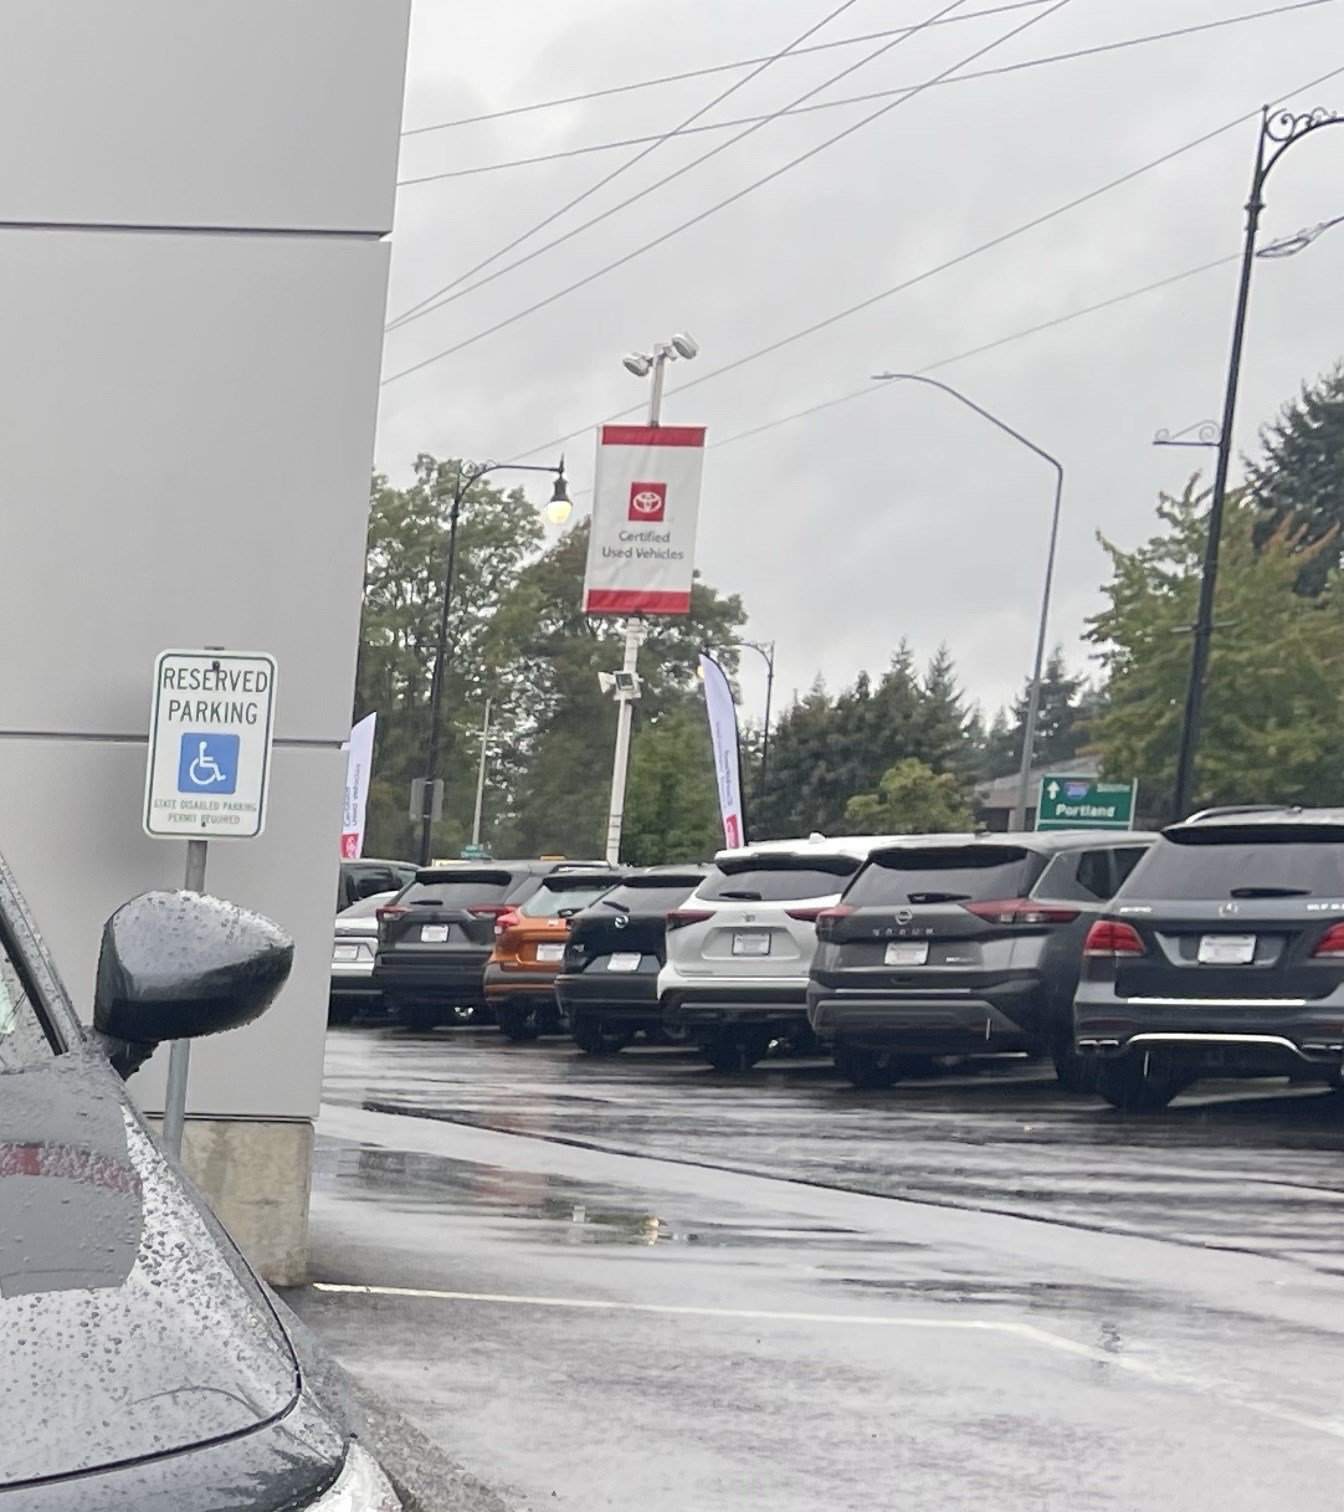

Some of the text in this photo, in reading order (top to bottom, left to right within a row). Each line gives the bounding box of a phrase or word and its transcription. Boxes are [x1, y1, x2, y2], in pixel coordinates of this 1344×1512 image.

[618, 530, 671, 543] Certified
[601, 545, 685, 560] Used Vehicles
[162, 667, 268, 693] RESERVED
[168, 699, 258, 725] PARKING
[1055, 803, 1117, 818] Portland
